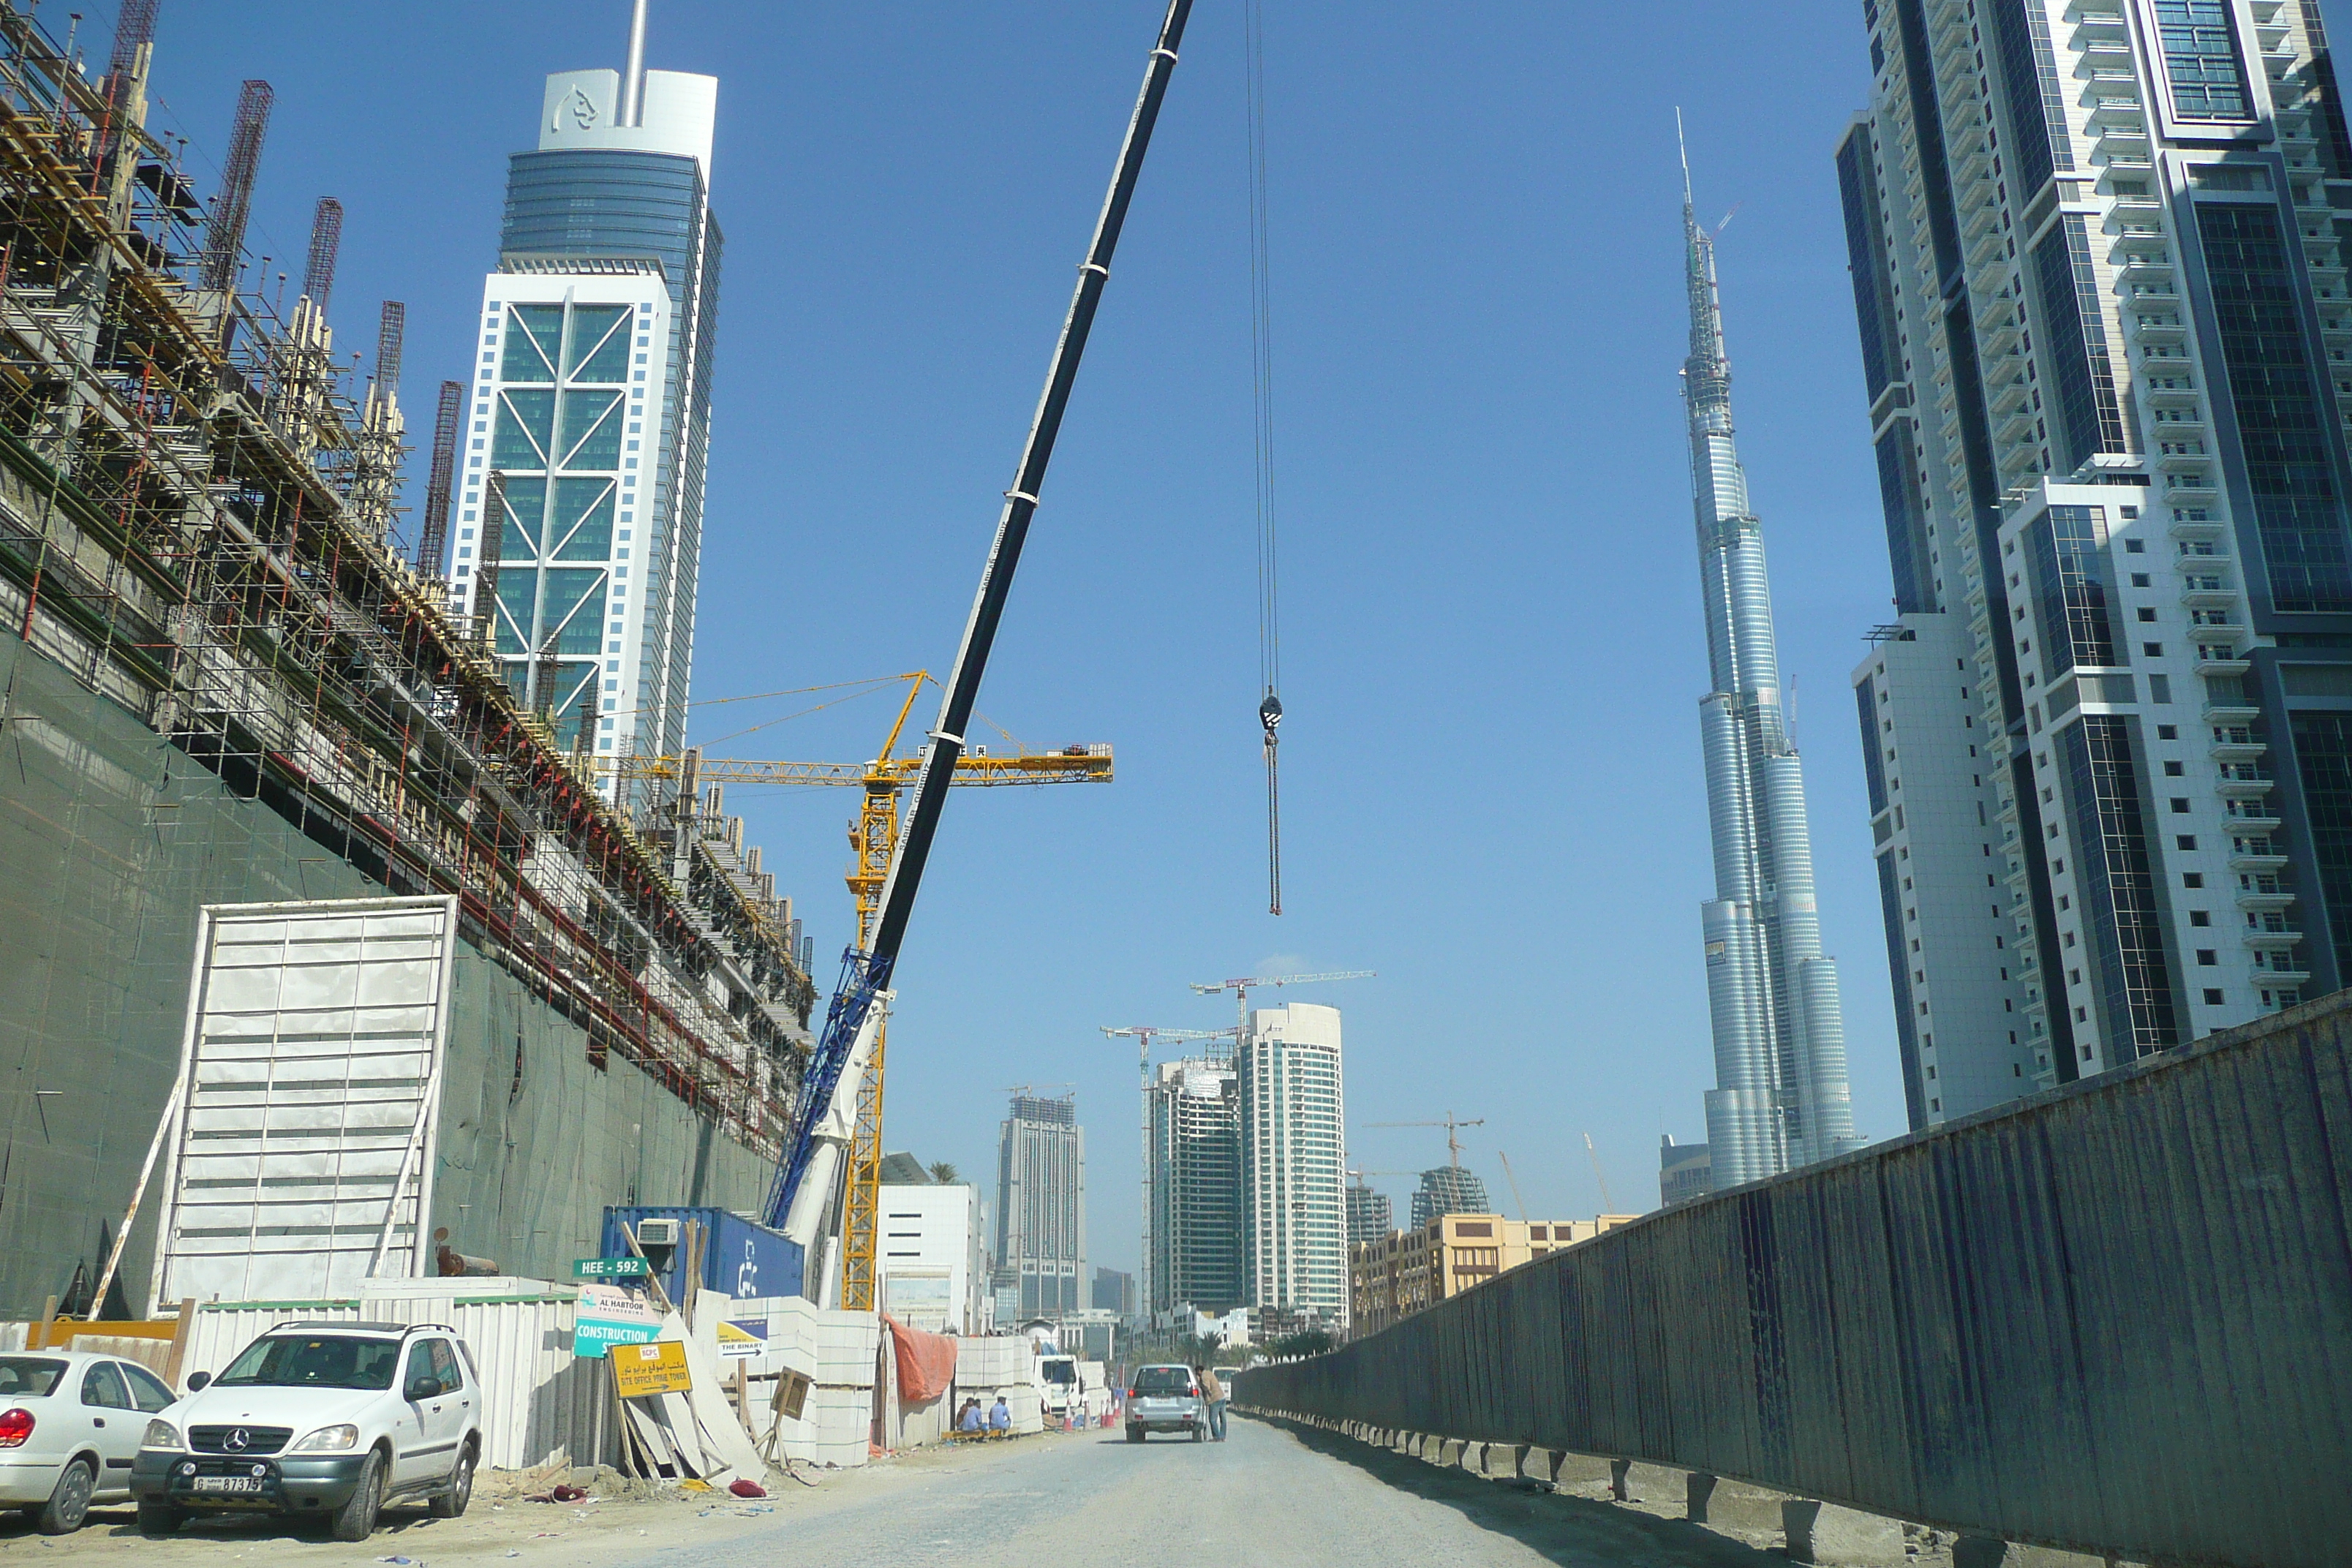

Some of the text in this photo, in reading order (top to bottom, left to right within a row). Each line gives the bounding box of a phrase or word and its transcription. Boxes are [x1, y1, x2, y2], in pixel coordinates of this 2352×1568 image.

[582, 1262, 604, 1274] HEE
[617, 1261, 638, 1273] 592
[611, 1300, 644, 1311] HABTOOR
[577, 1324, 648, 1343] CONSTRUCTION
[621, 1377, 633, 1386] SITE
[634, 1375, 652, 1384] OFFICE
[669, 1372, 687, 1381] TOWER
[197, 1478, 260, 1490] G 87375
